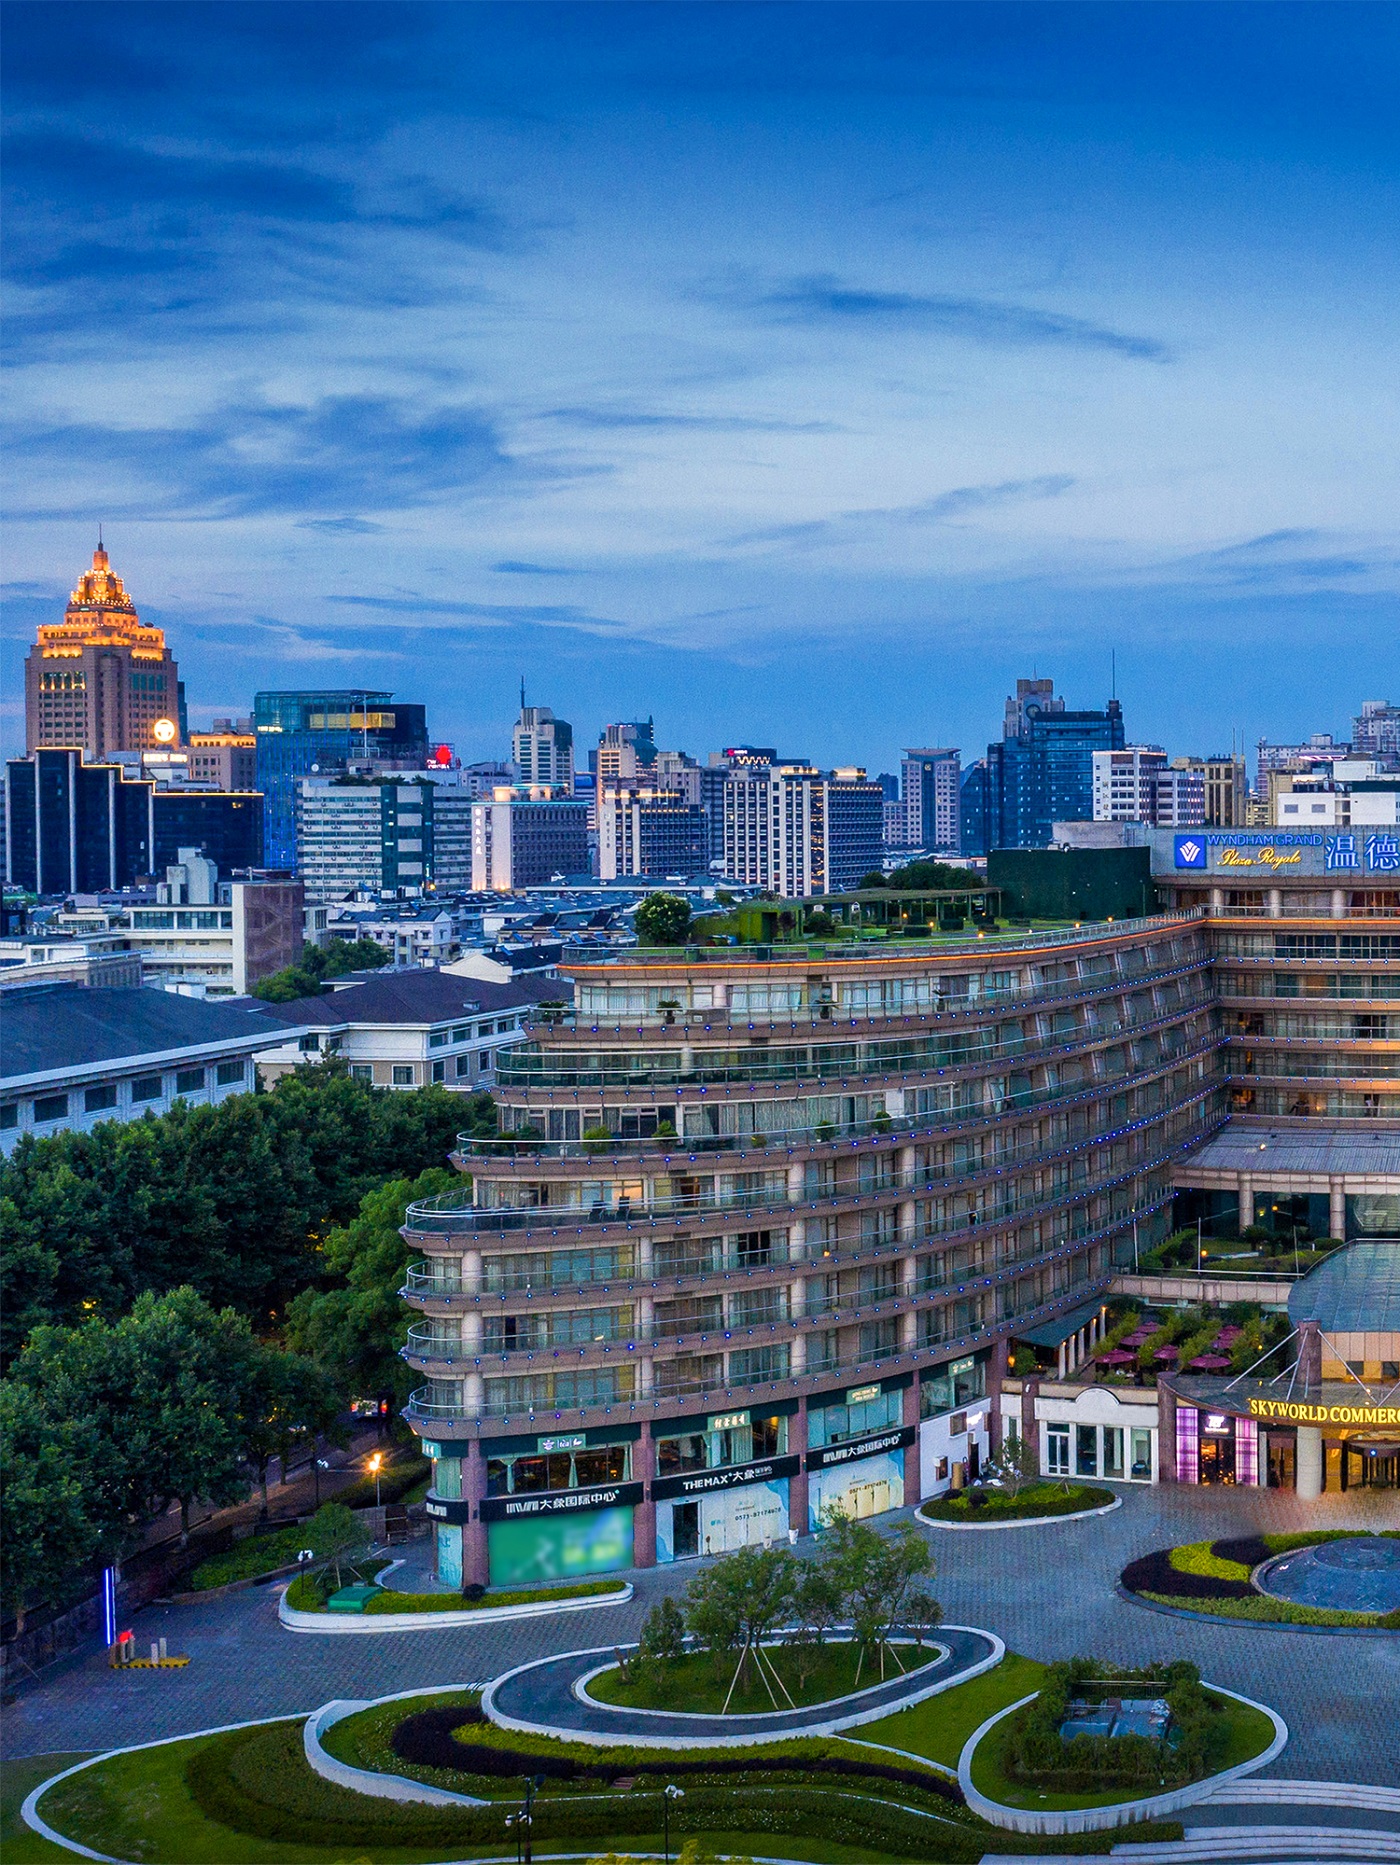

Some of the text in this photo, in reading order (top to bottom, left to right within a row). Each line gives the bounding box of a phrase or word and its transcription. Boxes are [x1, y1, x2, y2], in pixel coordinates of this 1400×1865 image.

[1207, 834, 1323, 846] WYNDHAM GRAND
[1216, 847, 1302, 870] Plaza Royale
[1250, 1400, 1328, 1422] SKYWORLD
